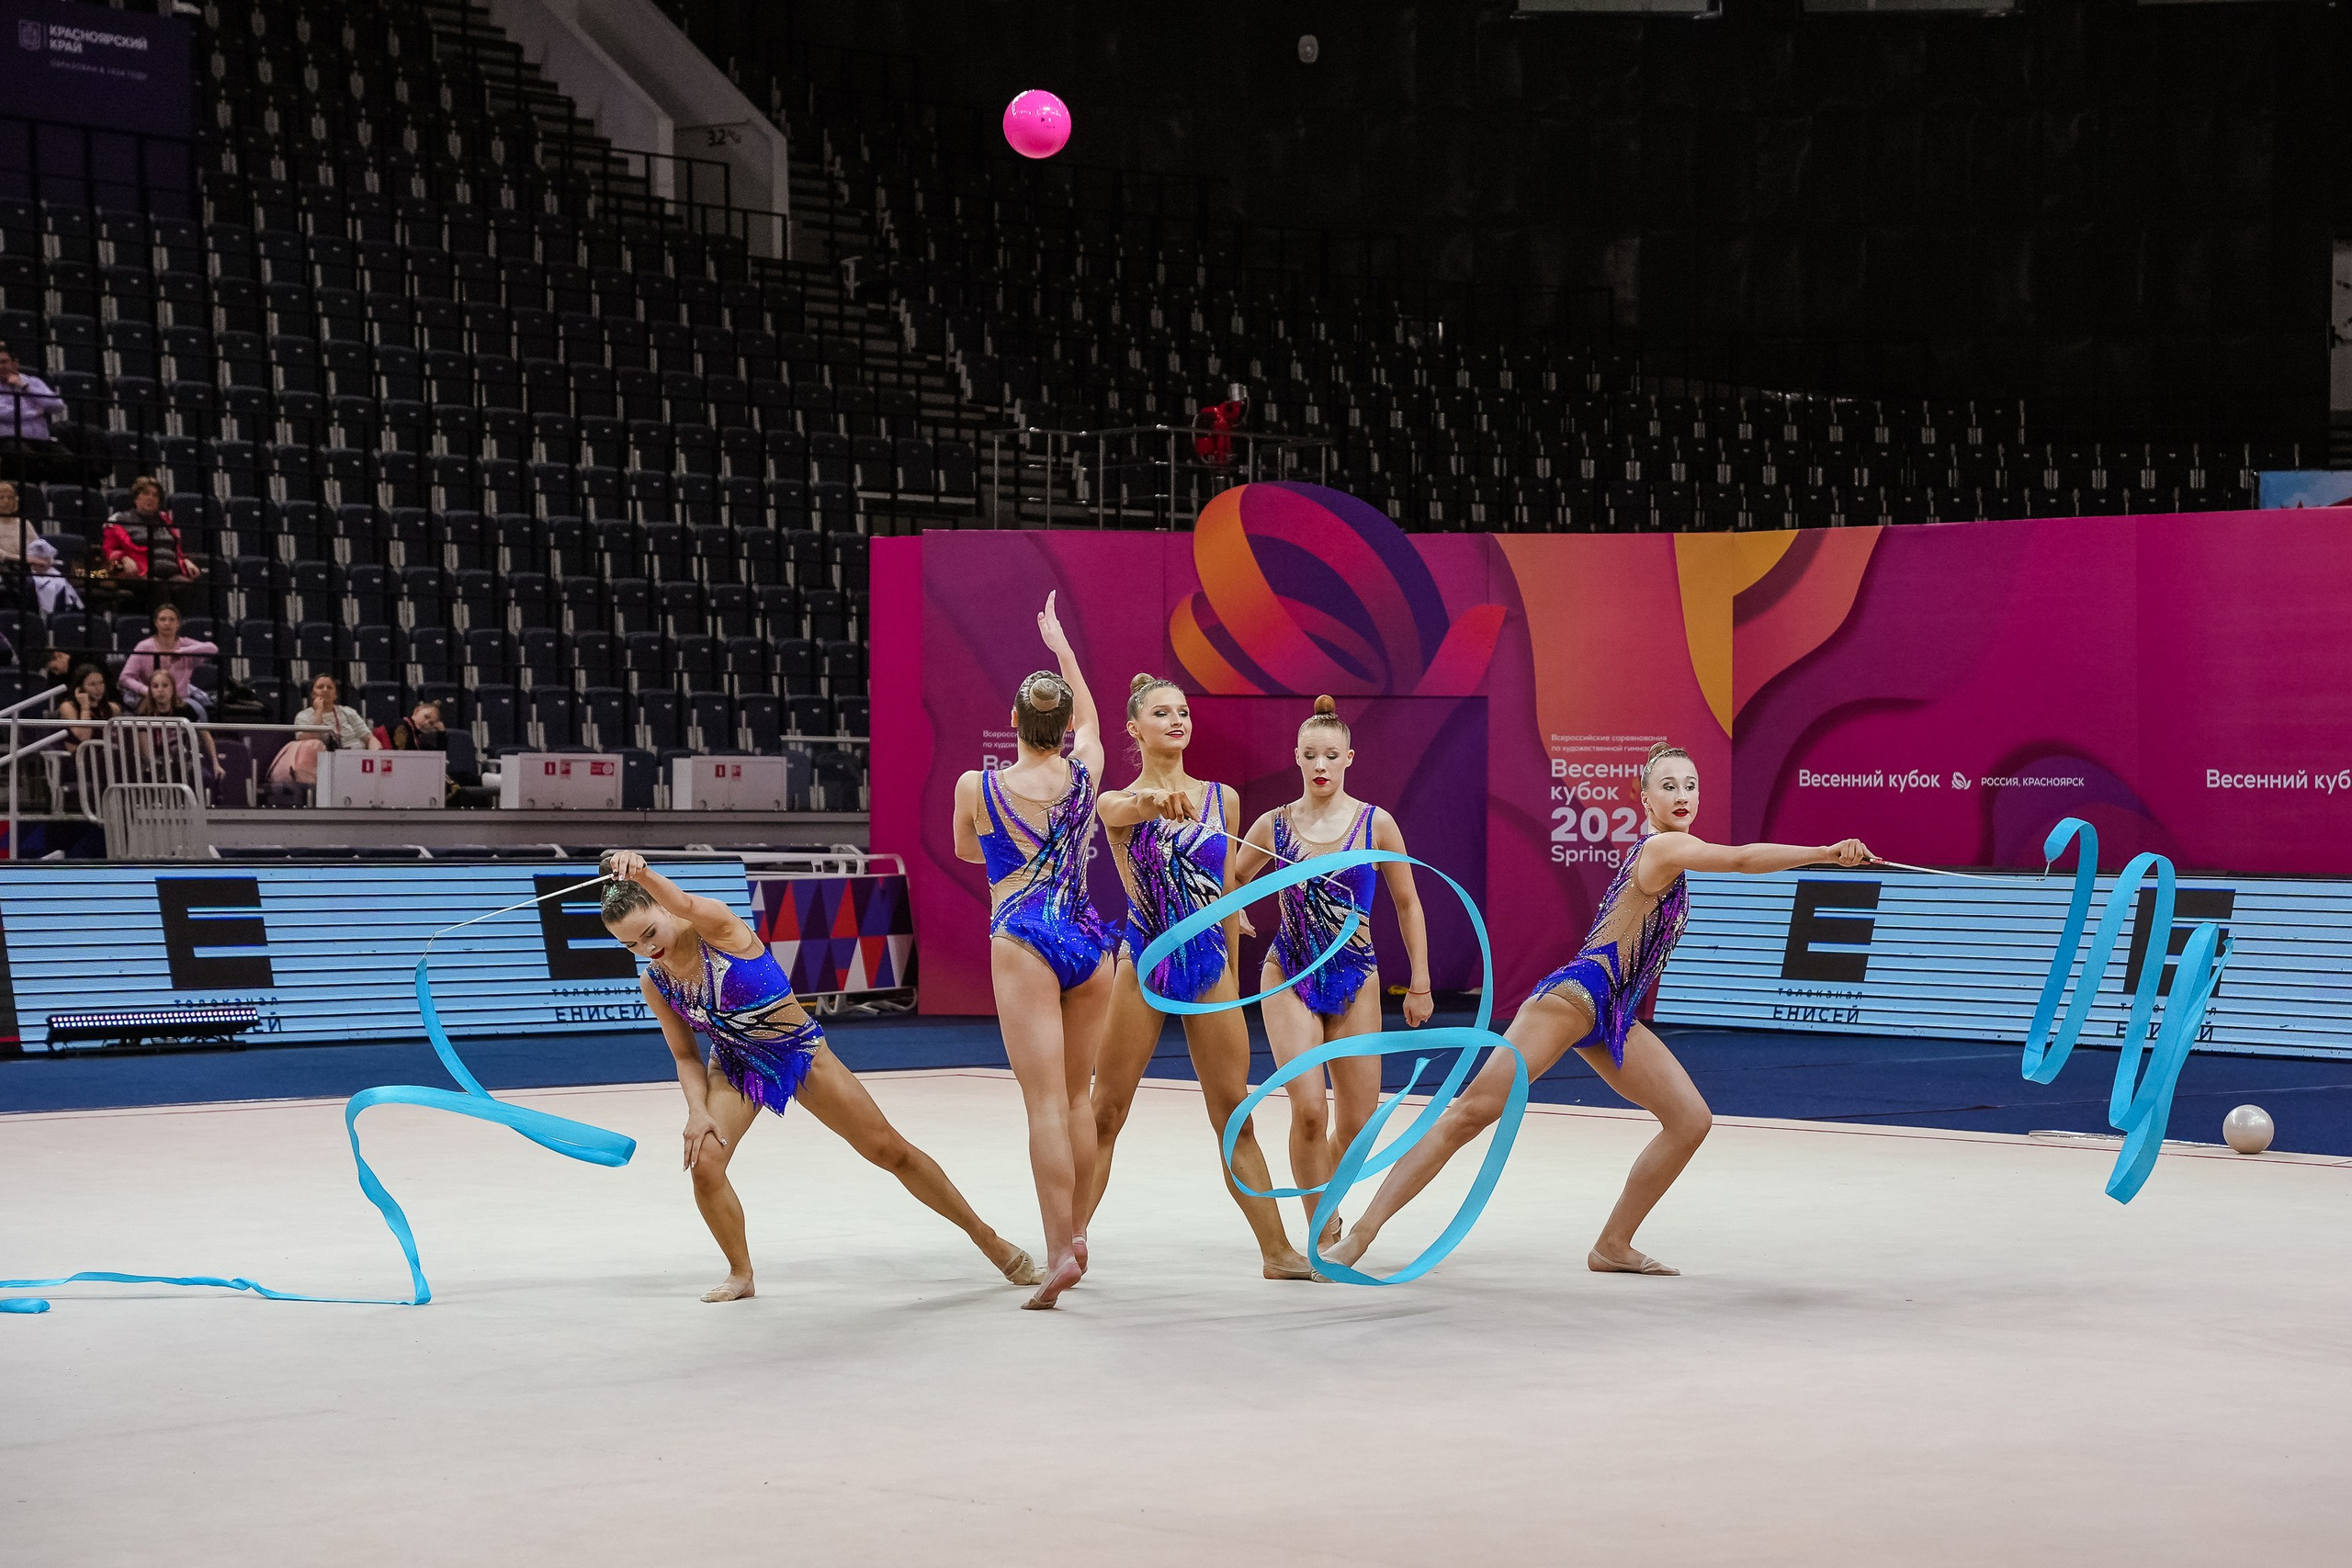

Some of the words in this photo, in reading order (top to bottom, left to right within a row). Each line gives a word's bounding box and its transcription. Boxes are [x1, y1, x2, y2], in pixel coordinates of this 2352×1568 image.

[50, 25, 148, 51] КРАСНОЯРСКИЙ
[50, 39, 83, 53] КРАЙ
[982, 729, 1018, 739] Всеросси
[1551, 734, 1610, 742] Всероссийские
[1562, 744, 1623, 752] художественной
[1551, 759, 1644, 778] Весенн
[1799, 769, 1883, 787] Весенний
[1888, 769, 1940, 793] кубок
[1981, 777, 2020, 787] РОССИЯ,
[2022, 777, 2085, 787] КРАСНОЯРСК
[2206, 769, 2308, 788] Весенний
[2314, 769, 2352, 795] куб
[1551, 781, 1620, 806] кубок
[1551, 844, 1621, 868] Spring
[555, 999, 646, 1021] ЕНИСЕЙ
[1773, 1005, 1860, 1023] ЕНИСЕЙ
